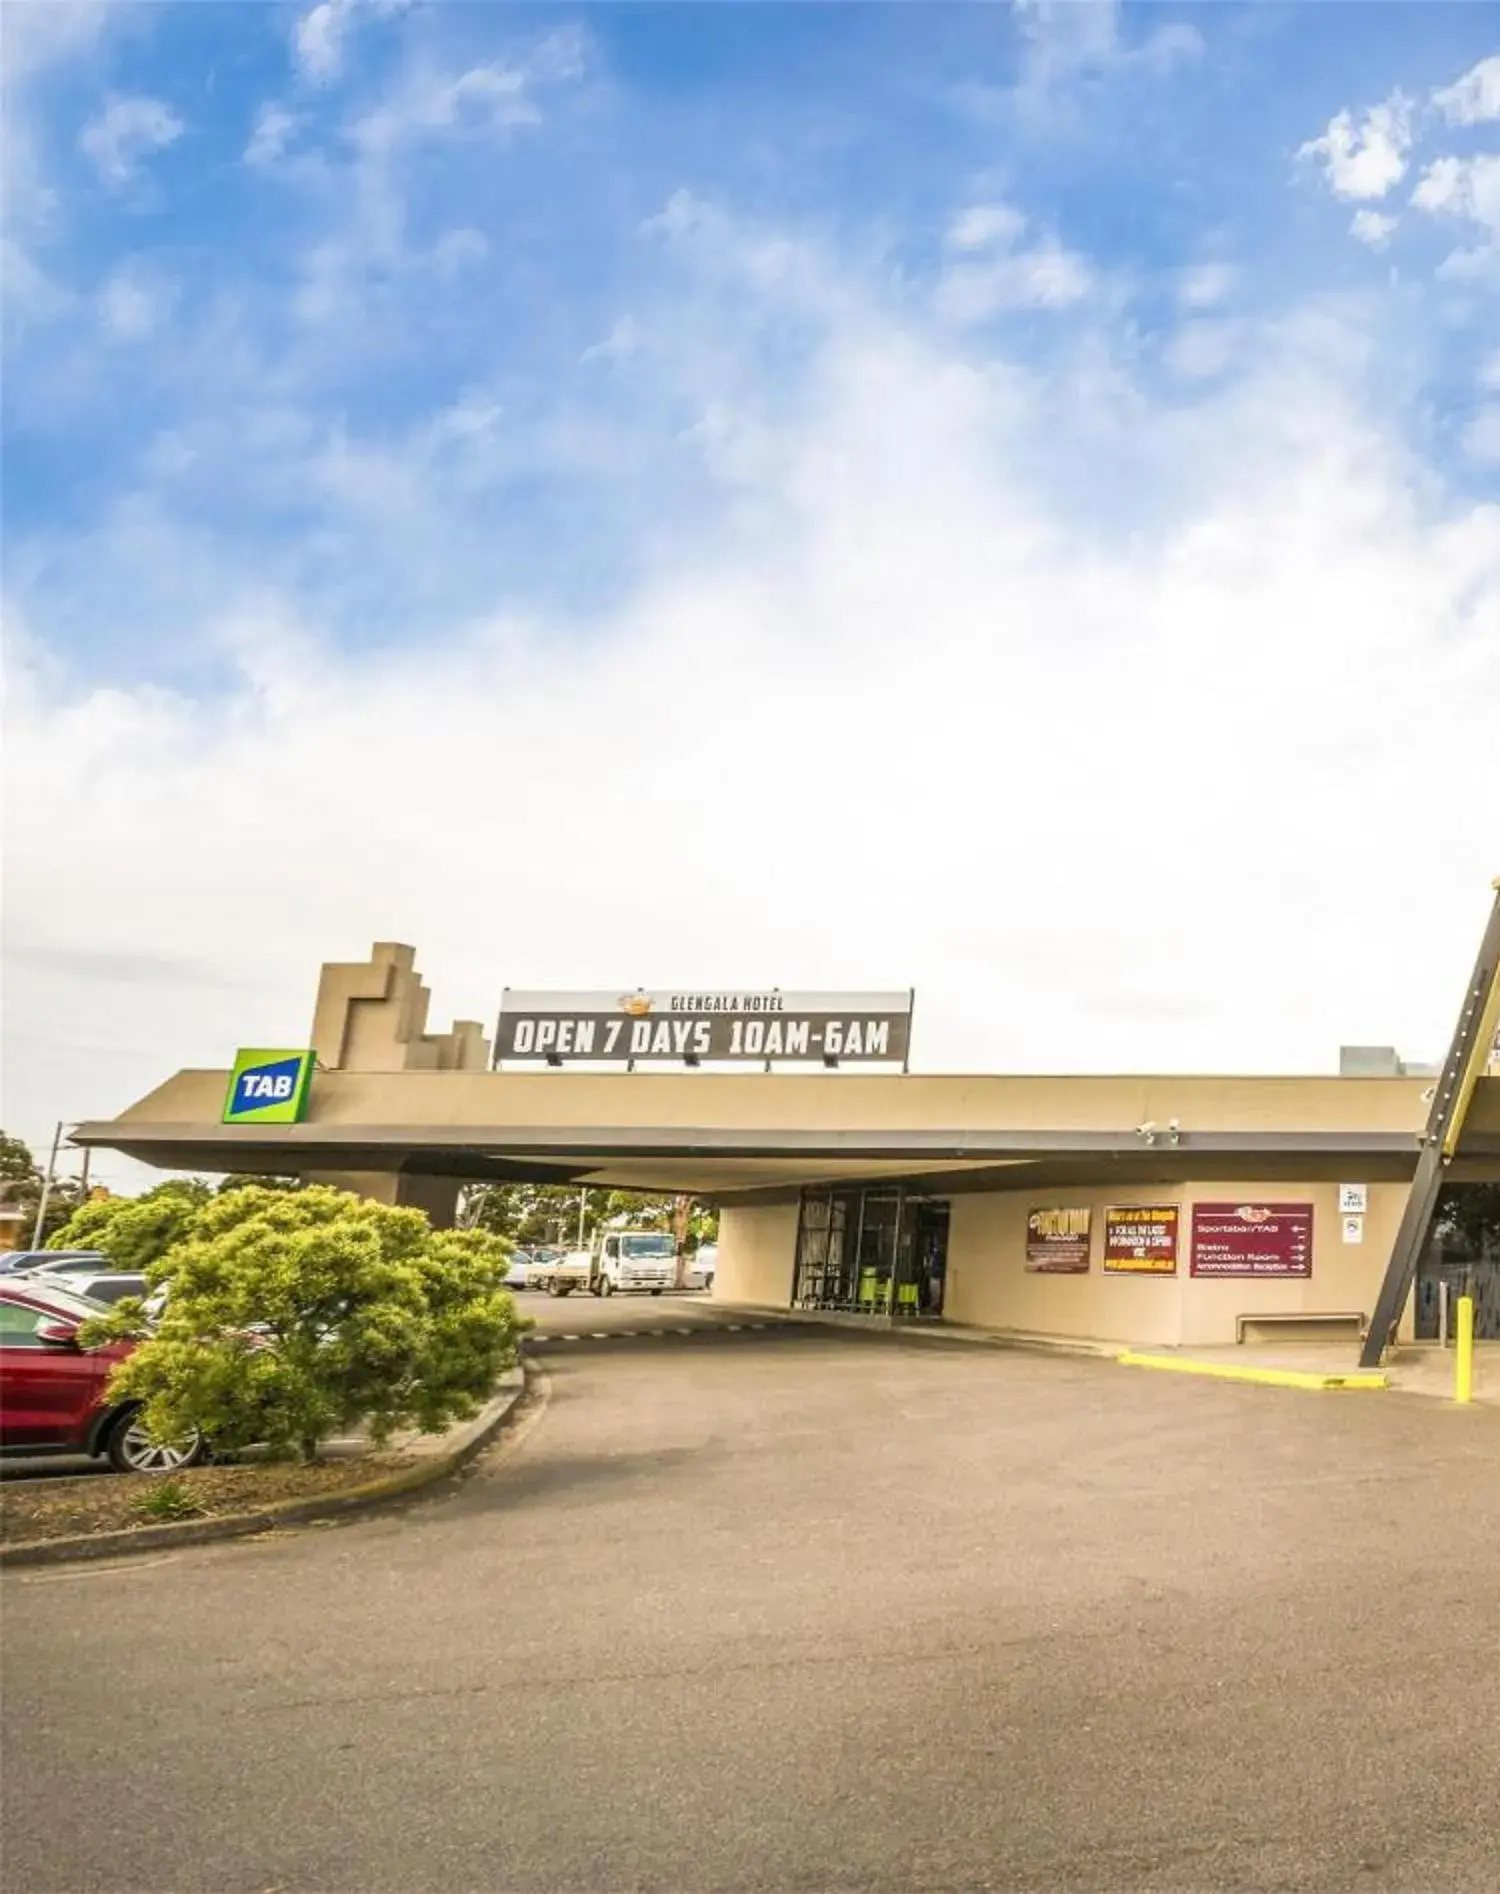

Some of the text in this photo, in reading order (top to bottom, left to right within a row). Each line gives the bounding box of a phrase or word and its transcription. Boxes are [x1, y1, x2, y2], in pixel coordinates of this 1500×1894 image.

[671, 996, 784, 1010] GLENGALA HOTEL
[513, 1020, 889, 1054] OPEN 7 DAYS 10AM-6AM
[242, 1075, 293, 1098] TAB
[1197, 1253, 1245, 1261] Function
